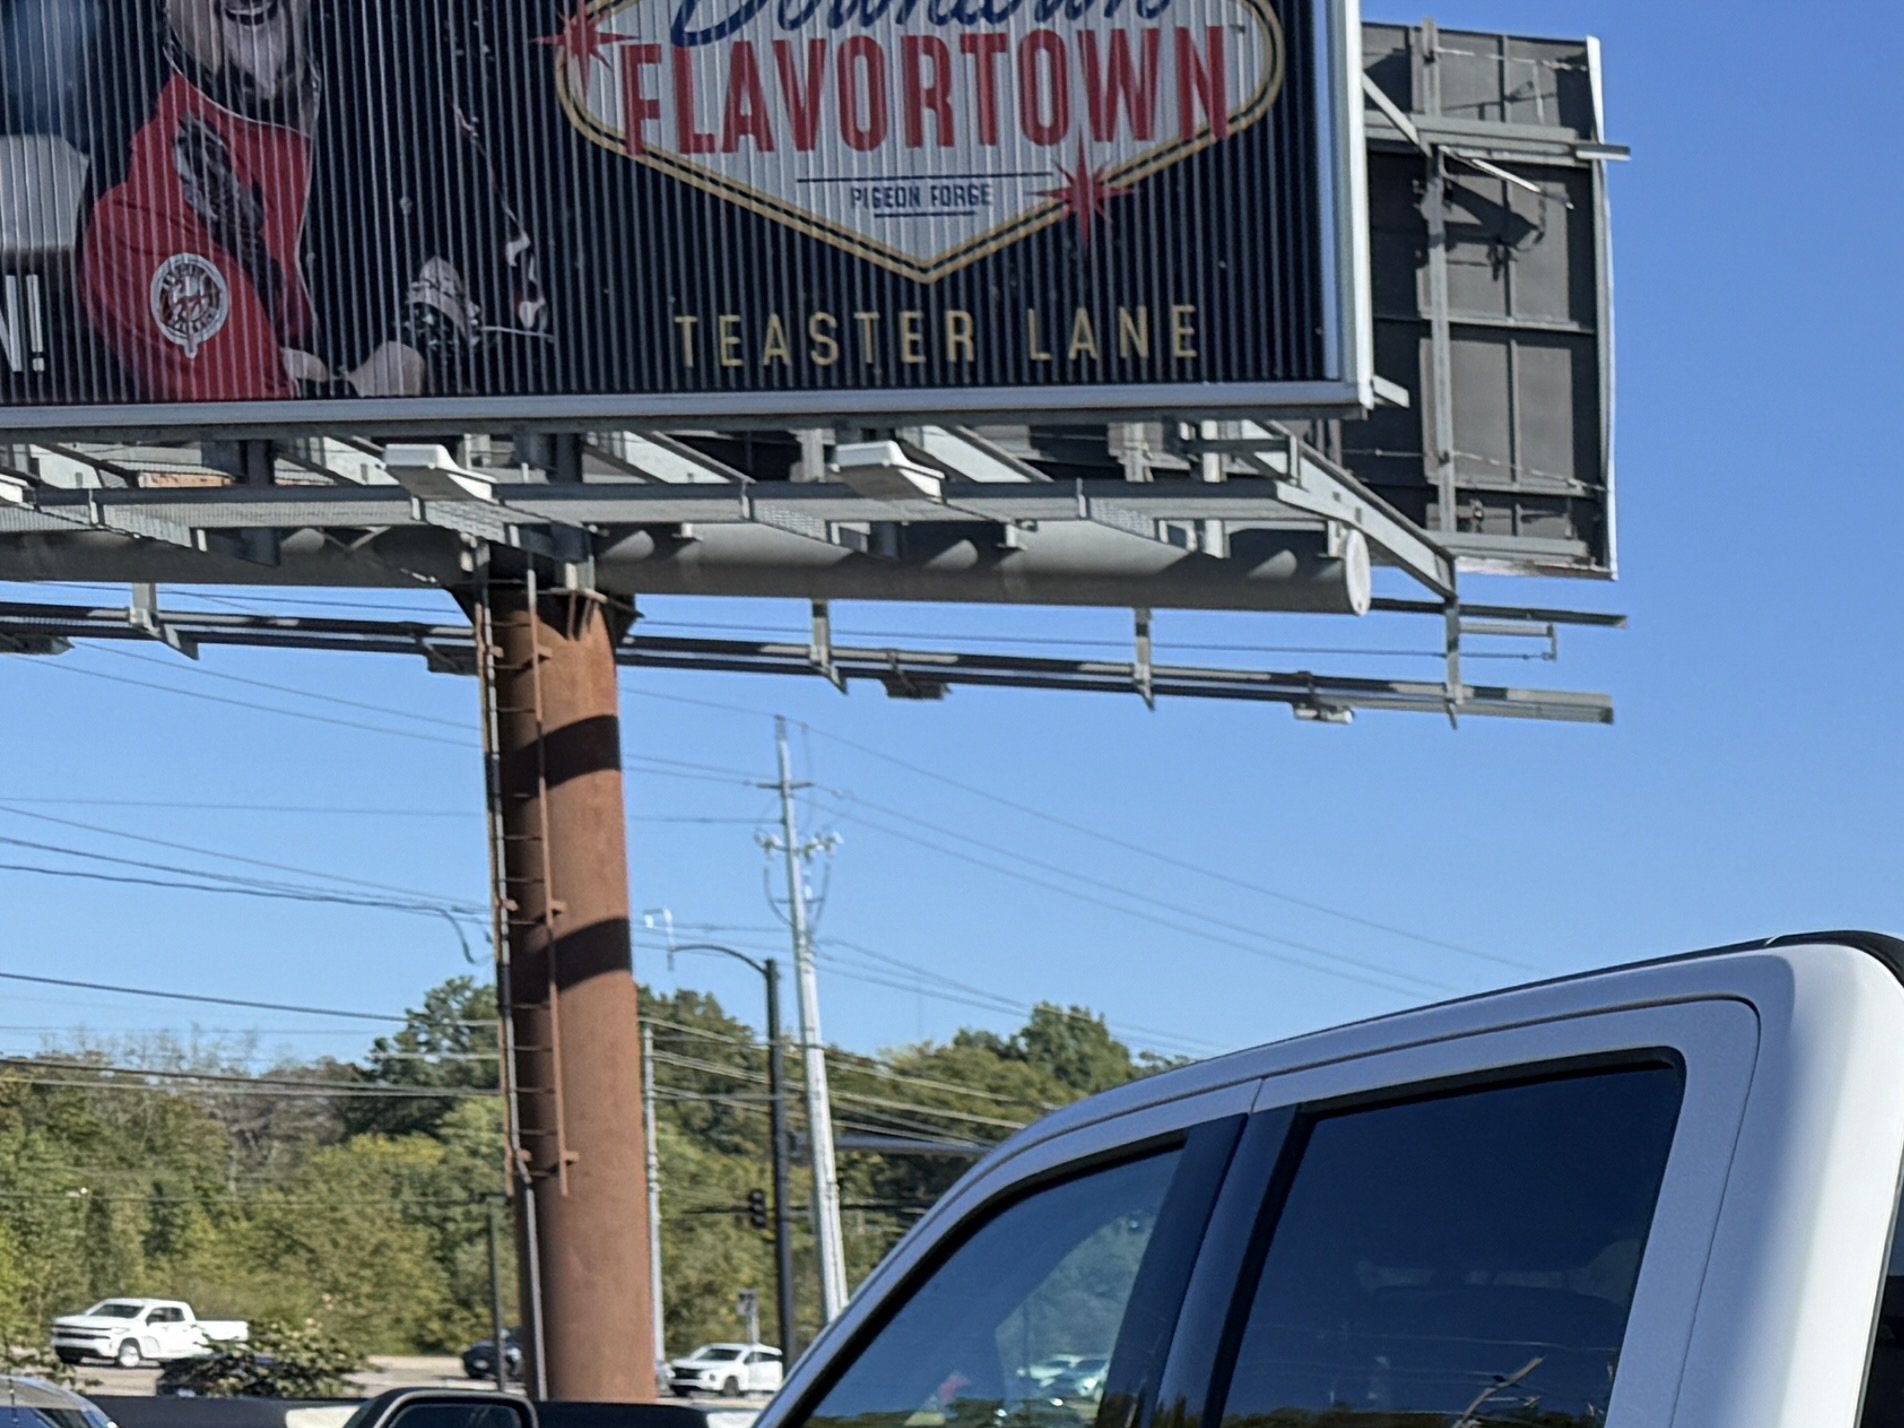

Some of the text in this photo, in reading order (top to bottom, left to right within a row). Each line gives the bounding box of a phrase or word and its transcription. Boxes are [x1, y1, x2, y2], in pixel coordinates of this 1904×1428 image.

[620, 25, 1229, 156] FLAVORTOWN
[850, 183, 991, 210] PIGEON FORGE
[674, 304, 1199, 368] TEASTER LANE
